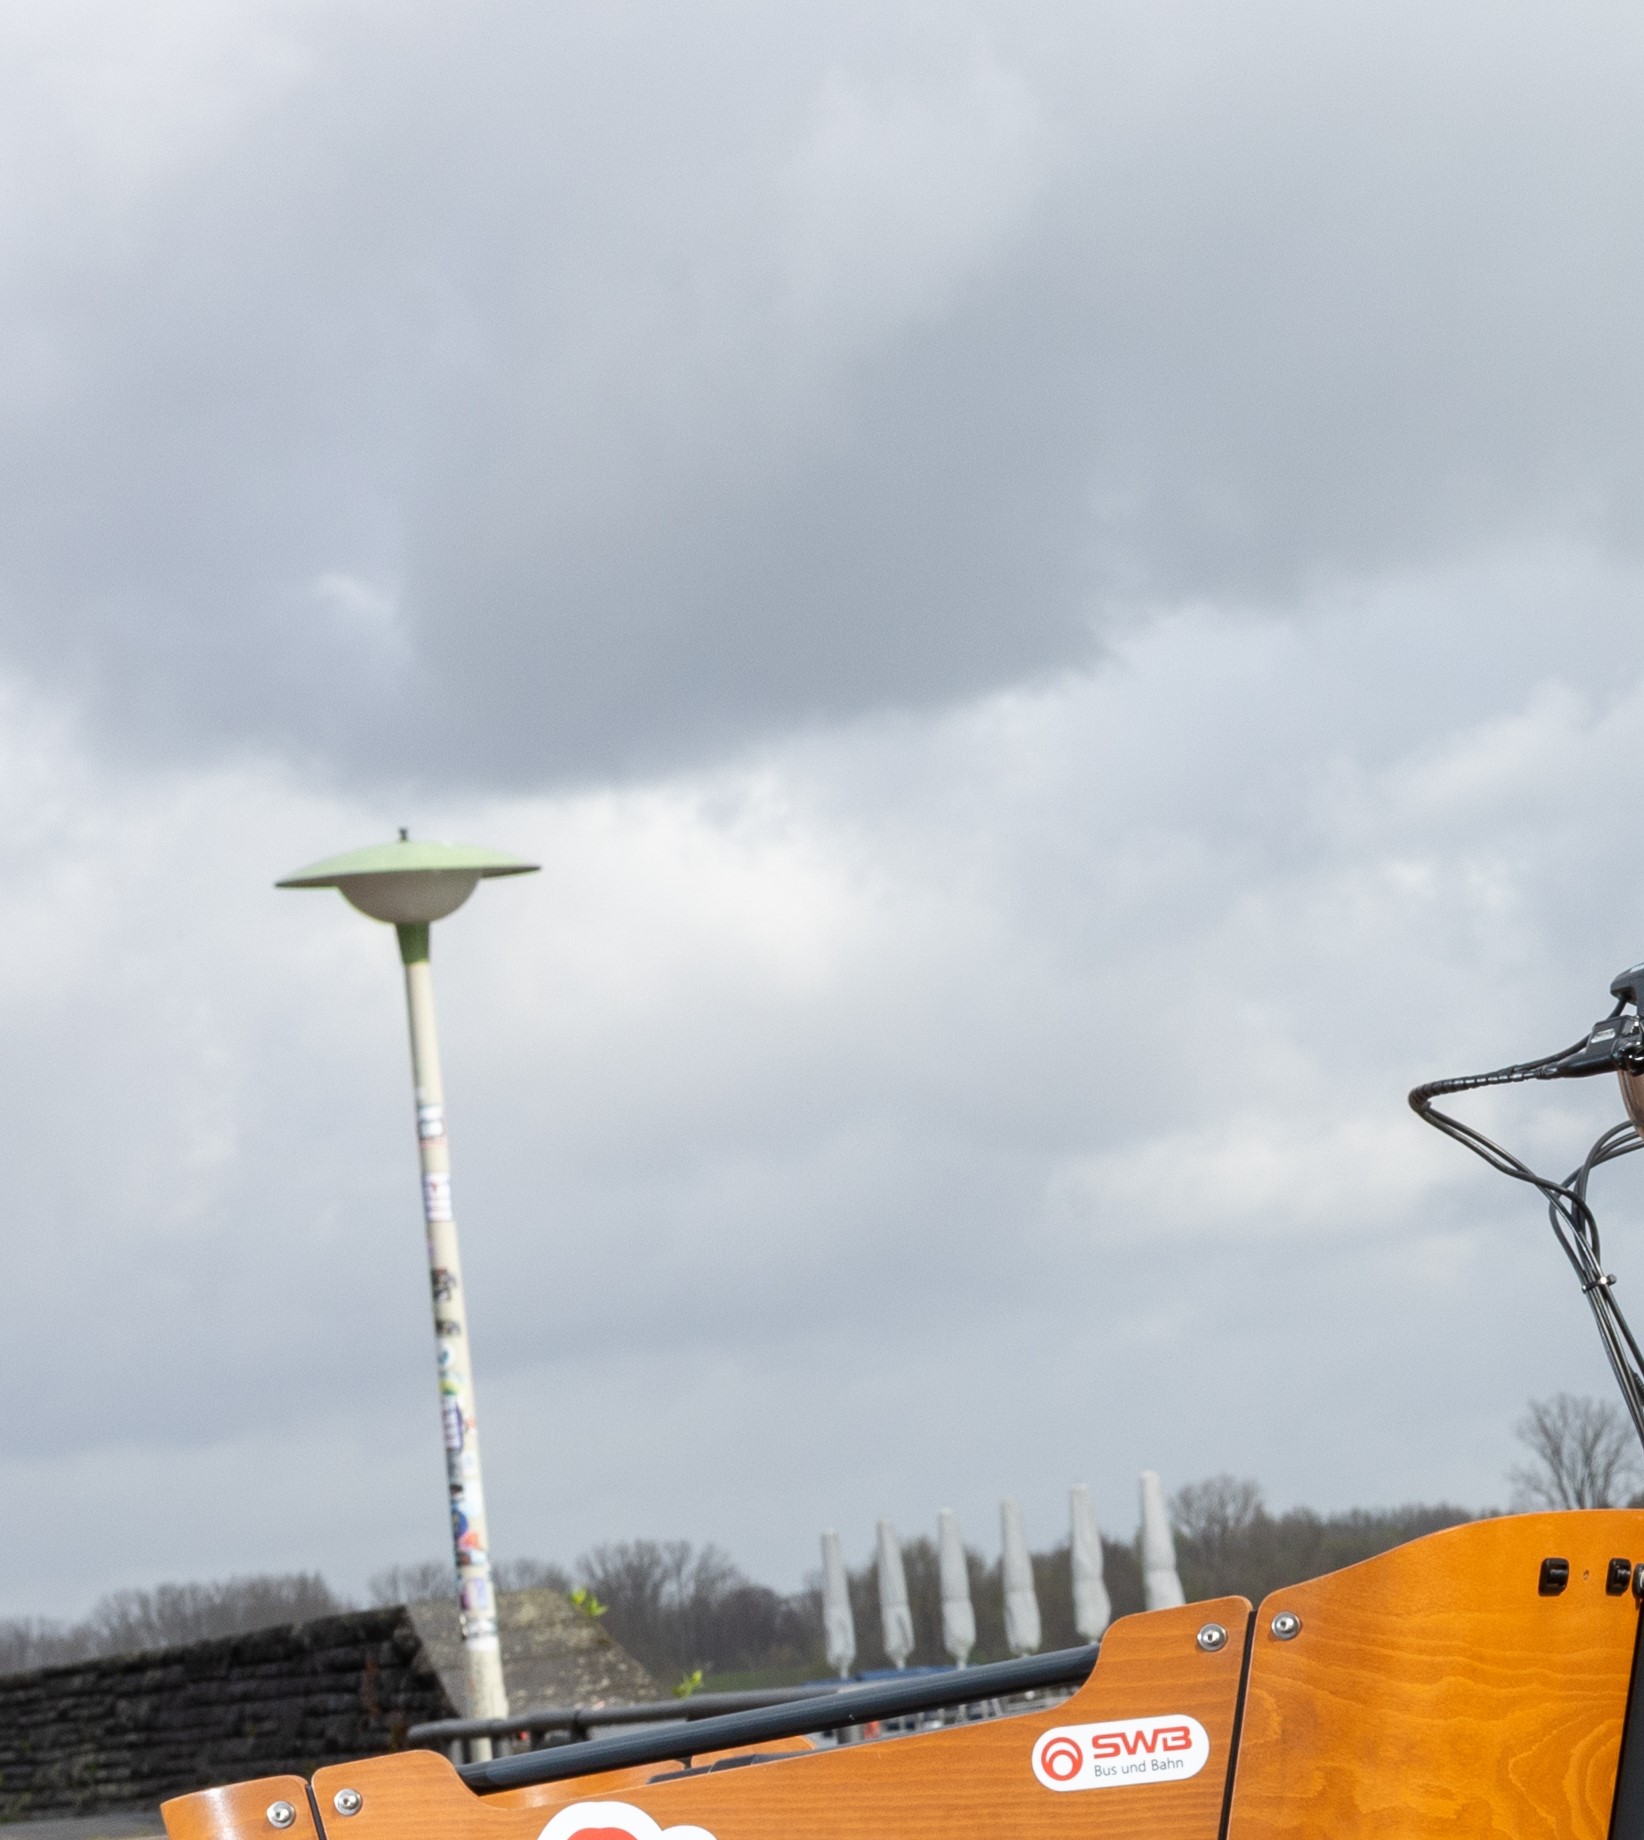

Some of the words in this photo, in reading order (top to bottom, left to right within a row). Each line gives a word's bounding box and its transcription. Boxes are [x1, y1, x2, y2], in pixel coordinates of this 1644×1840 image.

[1092, 1726, 1192, 1759] SWB
[1094, 1765, 1117, 1777] Bus
[1122, 1761, 1147, 1774] und
[1151, 1758, 1184, 1771] Bahn
